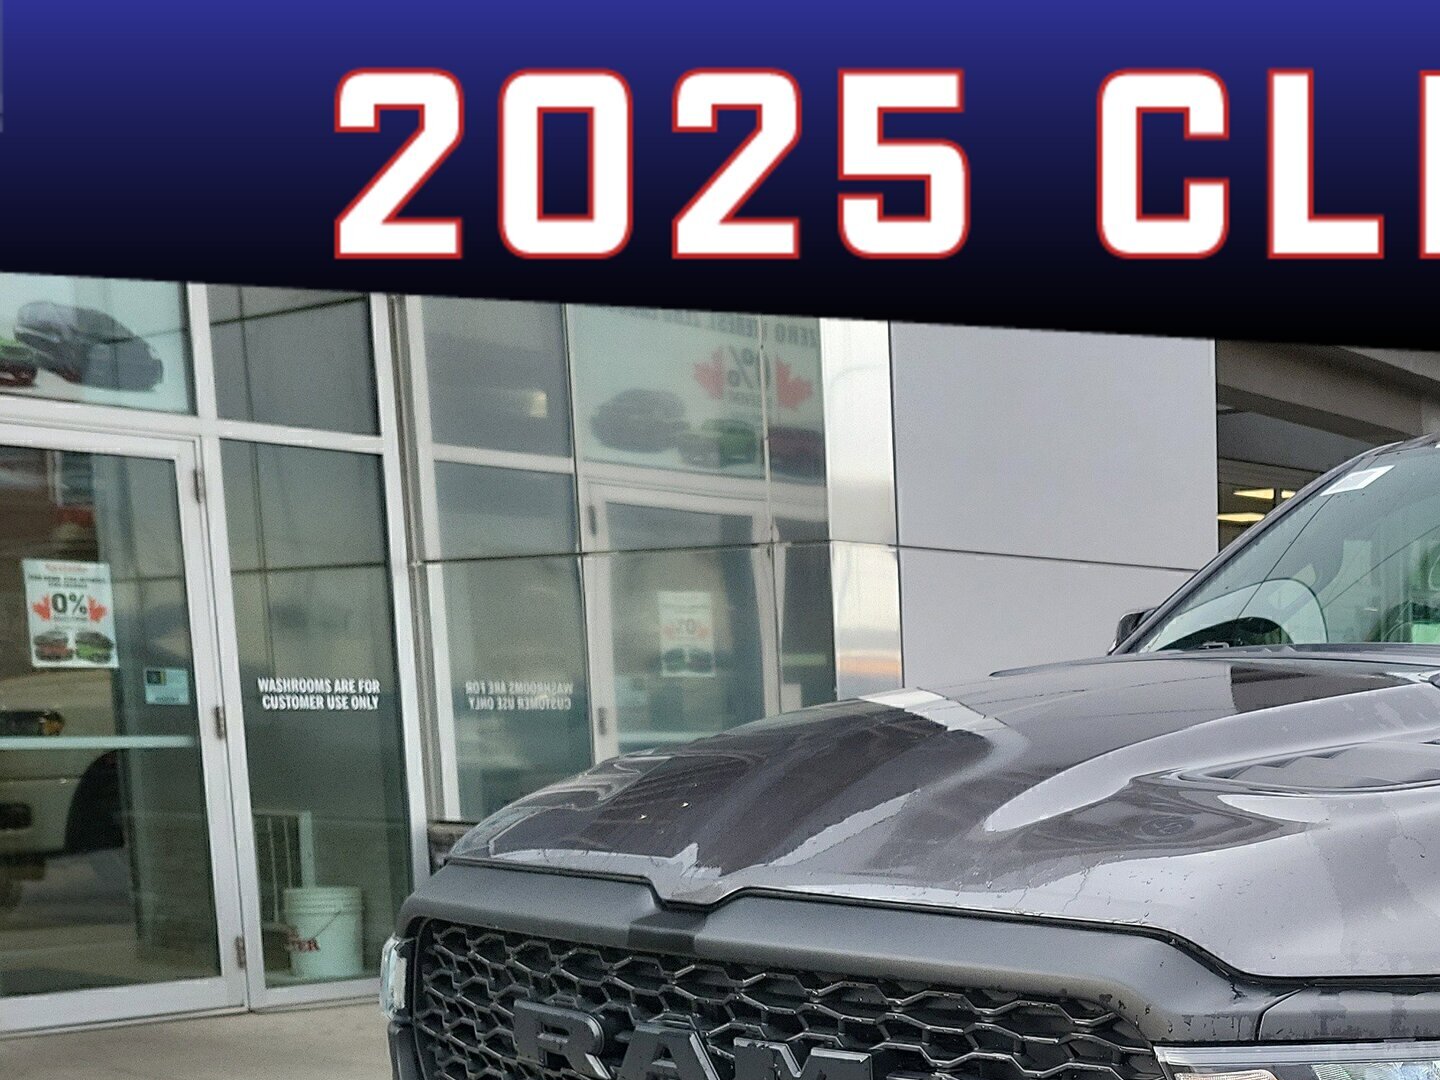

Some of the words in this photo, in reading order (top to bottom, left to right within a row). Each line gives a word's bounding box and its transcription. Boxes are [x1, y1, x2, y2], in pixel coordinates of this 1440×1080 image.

[52, 592, 88, 615] 0%
[257, 676, 332, 693] WASHROOMS
[334, 678, 356, 693] ARE
[358, 678, 381, 693] FOR
[262, 694, 325, 710] CUSTOMER
[326, 694, 349, 710] USE
[351, 694, 379, 710] ONLY
